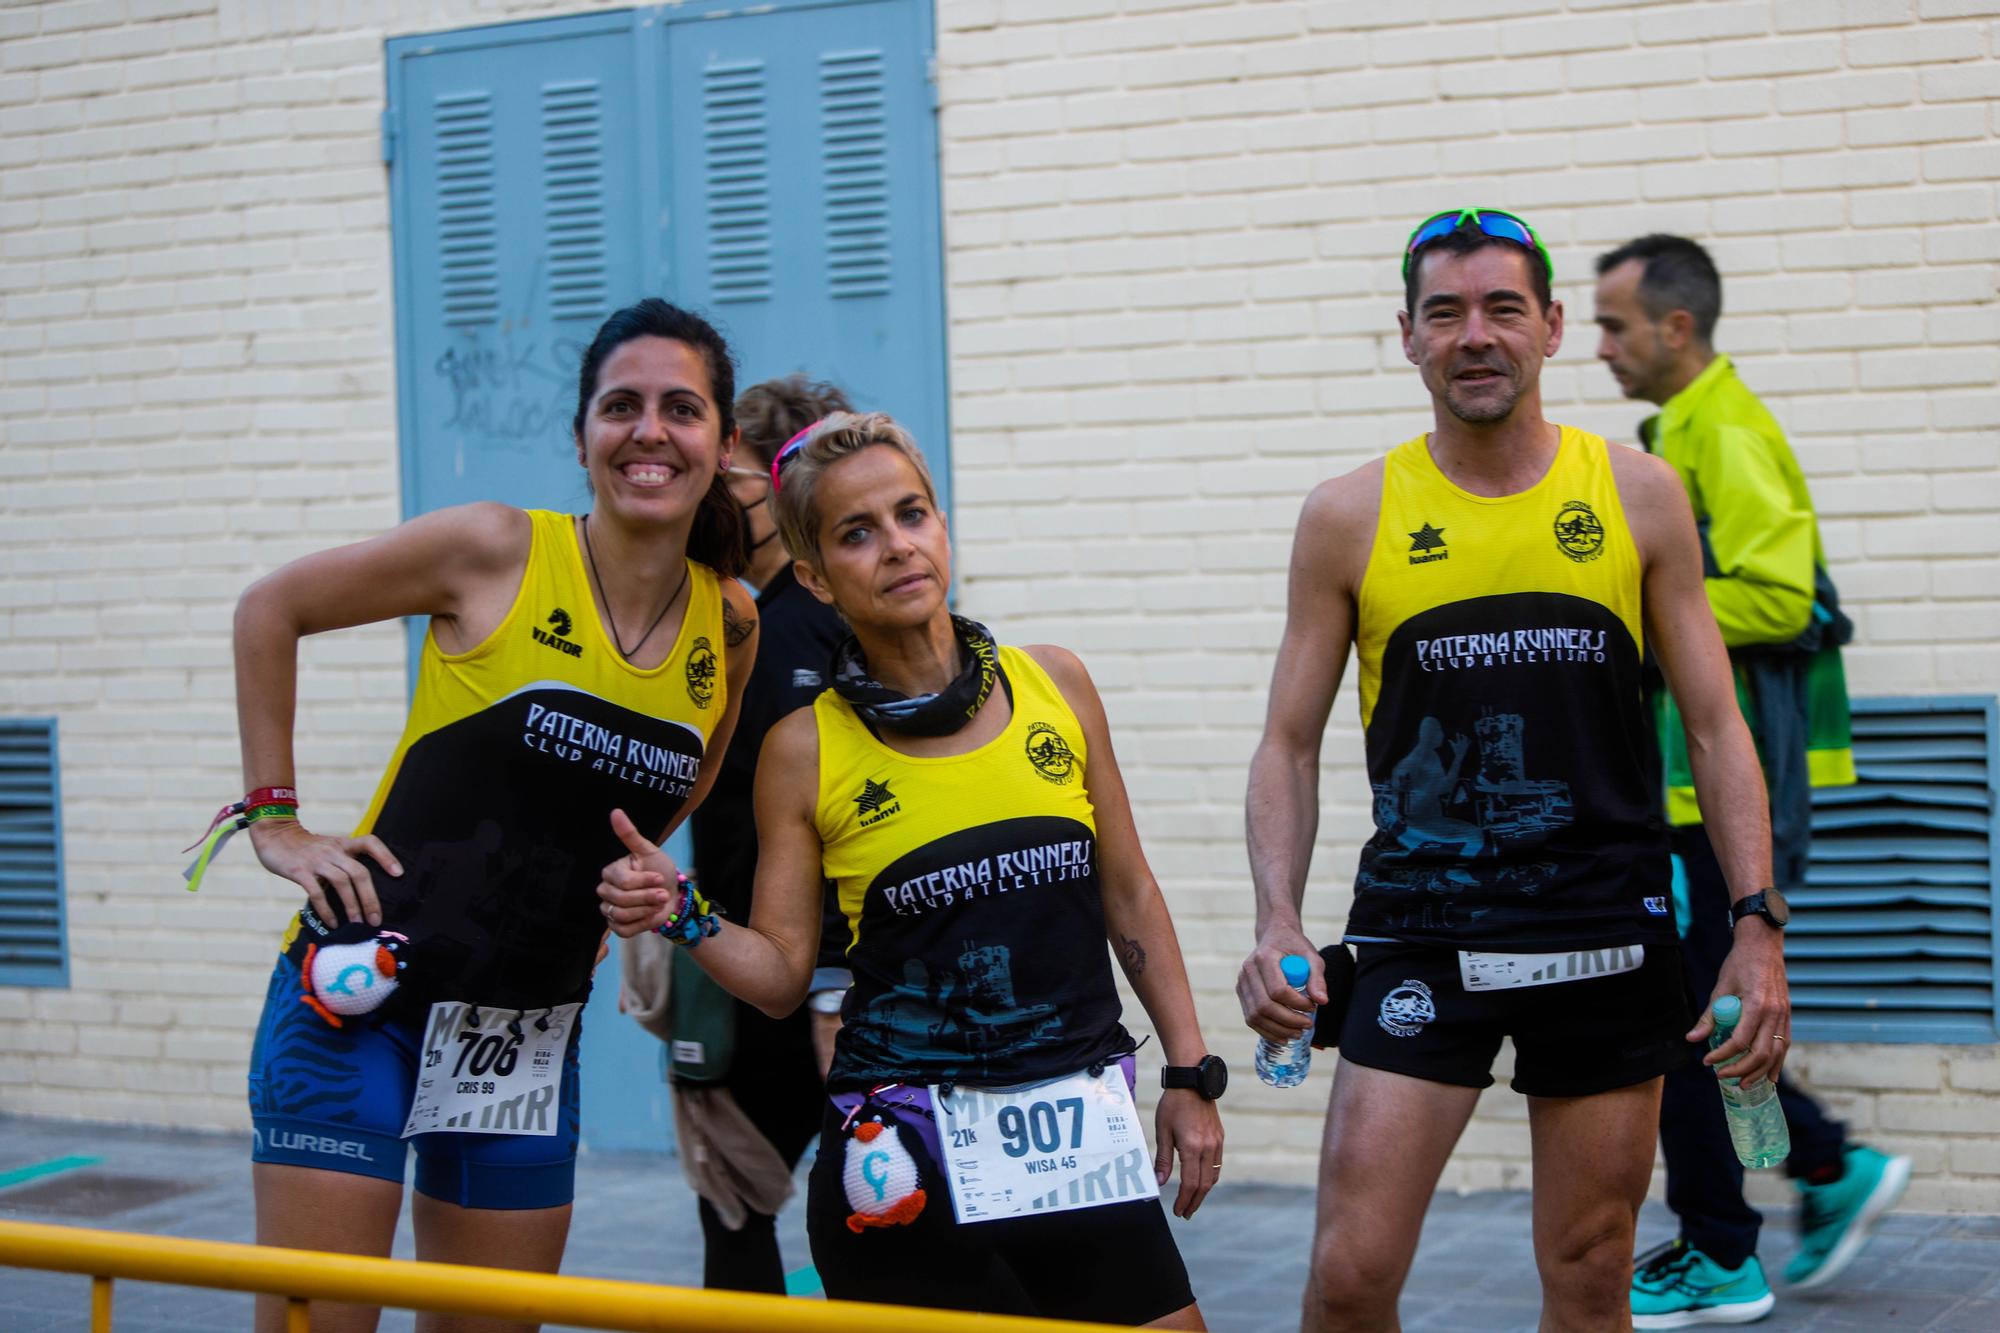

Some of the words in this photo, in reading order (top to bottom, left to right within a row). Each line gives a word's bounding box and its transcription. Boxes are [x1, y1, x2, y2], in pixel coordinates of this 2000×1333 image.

[532, 626, 583, 658] VIATOR
[1416, 632, 1510, 661] PATERNA
[1513, 628, 1607, 650] RUNNERS
[1421, 656, 1475, 672] CLUB
[1483, 649, 1606, 667] ATLETISMO
[523, 732, 583, 762] CLUB
[526, 702, 623, 758] PATERNA
[625, 738, 701, 782] RUNNERS
[883, 858, 992, 909] PATERNA
[996, 839, 1091, 871] RUNNERS
[964, 864, 1091, 899] ATLETISMO
[451, 1031, 525, 1078] 706
[456, 1081, 479, 1094] CRIS
[481, 1081, 495, 1094] 99
[997, 1097, 1084, 1158] 907
[269, 1128, 374, 1161] LURBEL
[1025, 1158, 1057, 1175] WISA
[1061, 1156, 1077, 1169] 45
